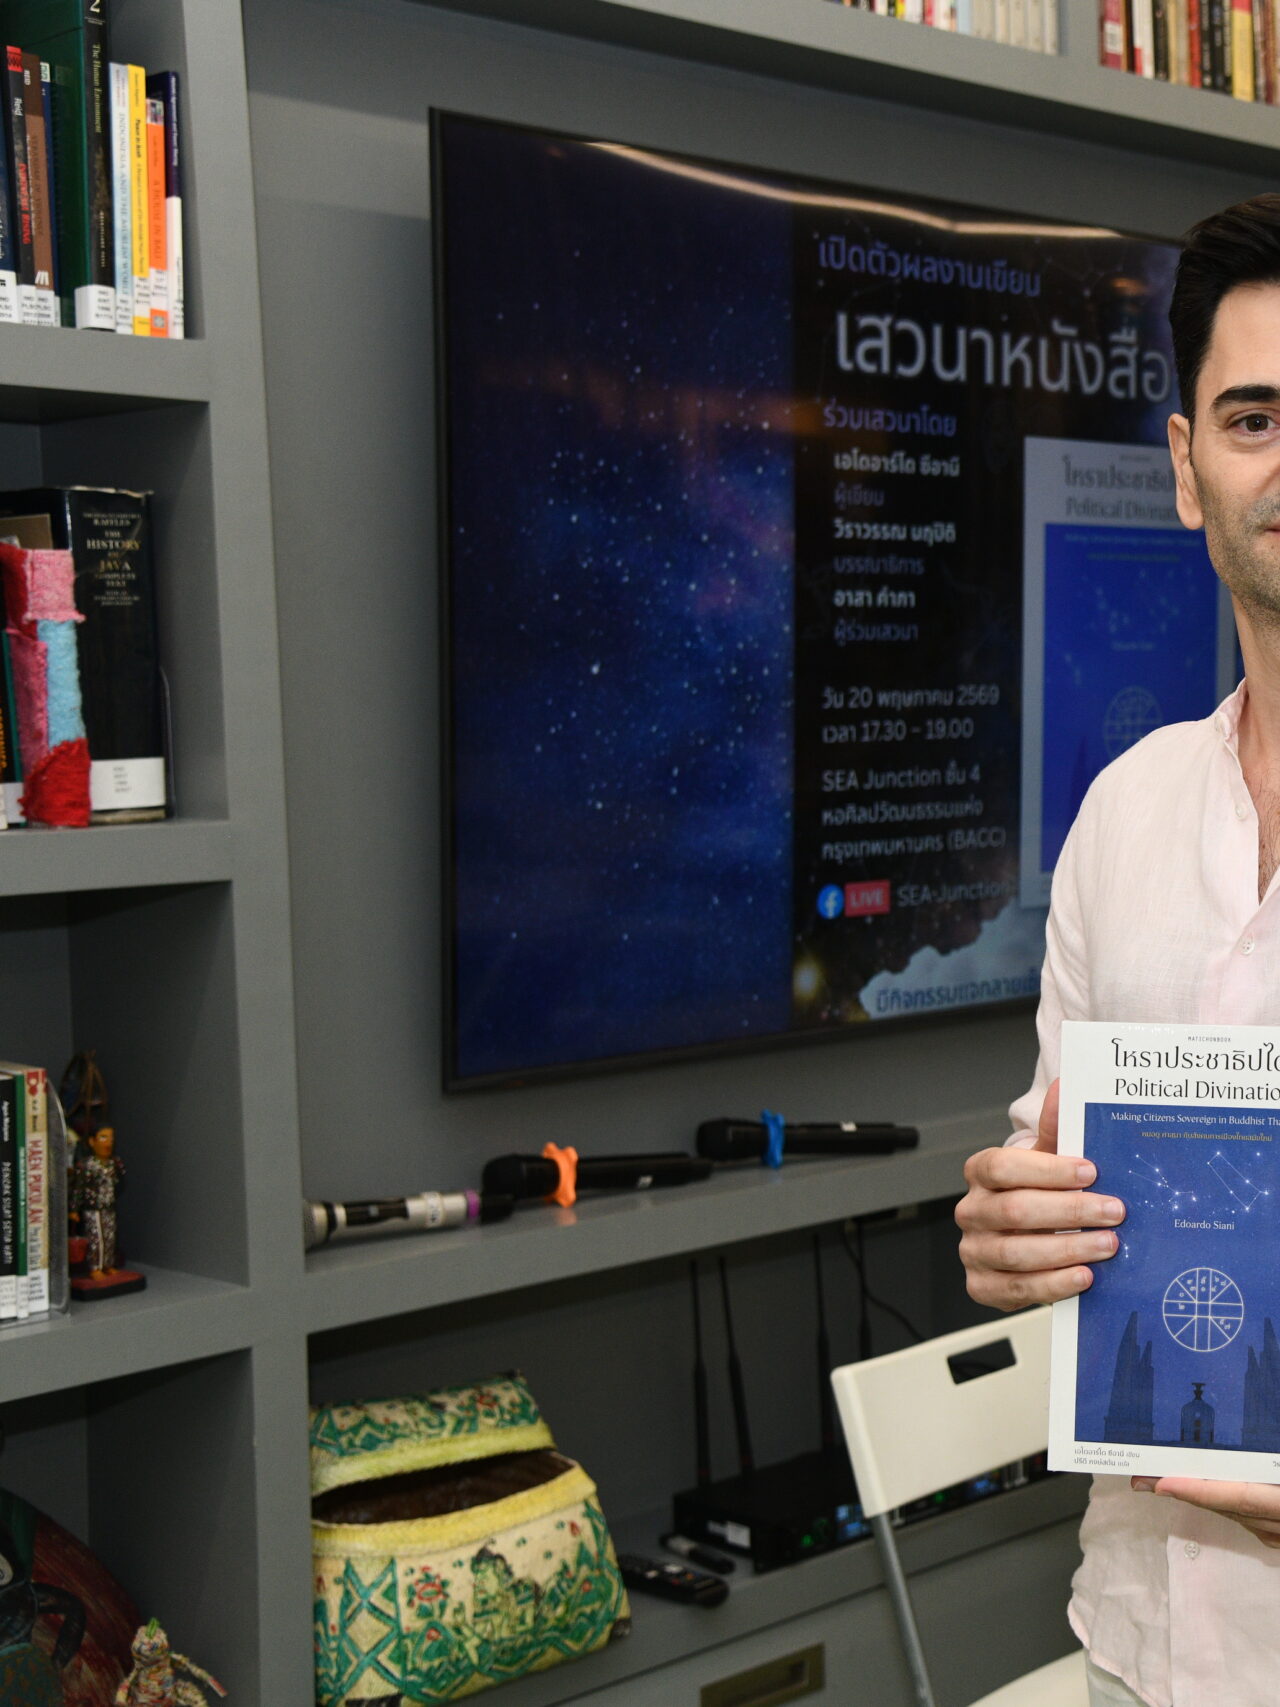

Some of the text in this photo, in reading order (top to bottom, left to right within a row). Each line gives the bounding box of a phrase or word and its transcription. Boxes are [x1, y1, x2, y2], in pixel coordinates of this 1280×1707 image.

[818, 235, 1041, 298] เปิดตัวผลงานเขียน
[836, 311, 1171, 402] เสวนาหนังสือ
[823, 397, 957, 437] ร่วมเสวนาโดย
[86, 538, 141, 550] HISTORY
[99, 560, 131, 571] JAVA
[848, 686, 873, 709] 20
[861, 719, 905, 743] 17.30
[822, 770, 859, 792] SEA
[863, 766, 941, 790] Junction
[968, 764, 980, 783] 4
[948, 826, 1006, 850] (BACC)
[850, 888, 884, 907] LIVE
[1114, 1077, 1189, 1098] Political
[1111, 1112, 1141, 1124] Making
[1143, 1113, 1175, 1122] Citizens
[1176, 1114, 1217, 1127] Sovereign
[1219, 1115, 1227, 1124] in
[1229, 1115, 1265, 1126] Buddhist
[1174, 1218, 1235, 1230] Edoardo Siani
